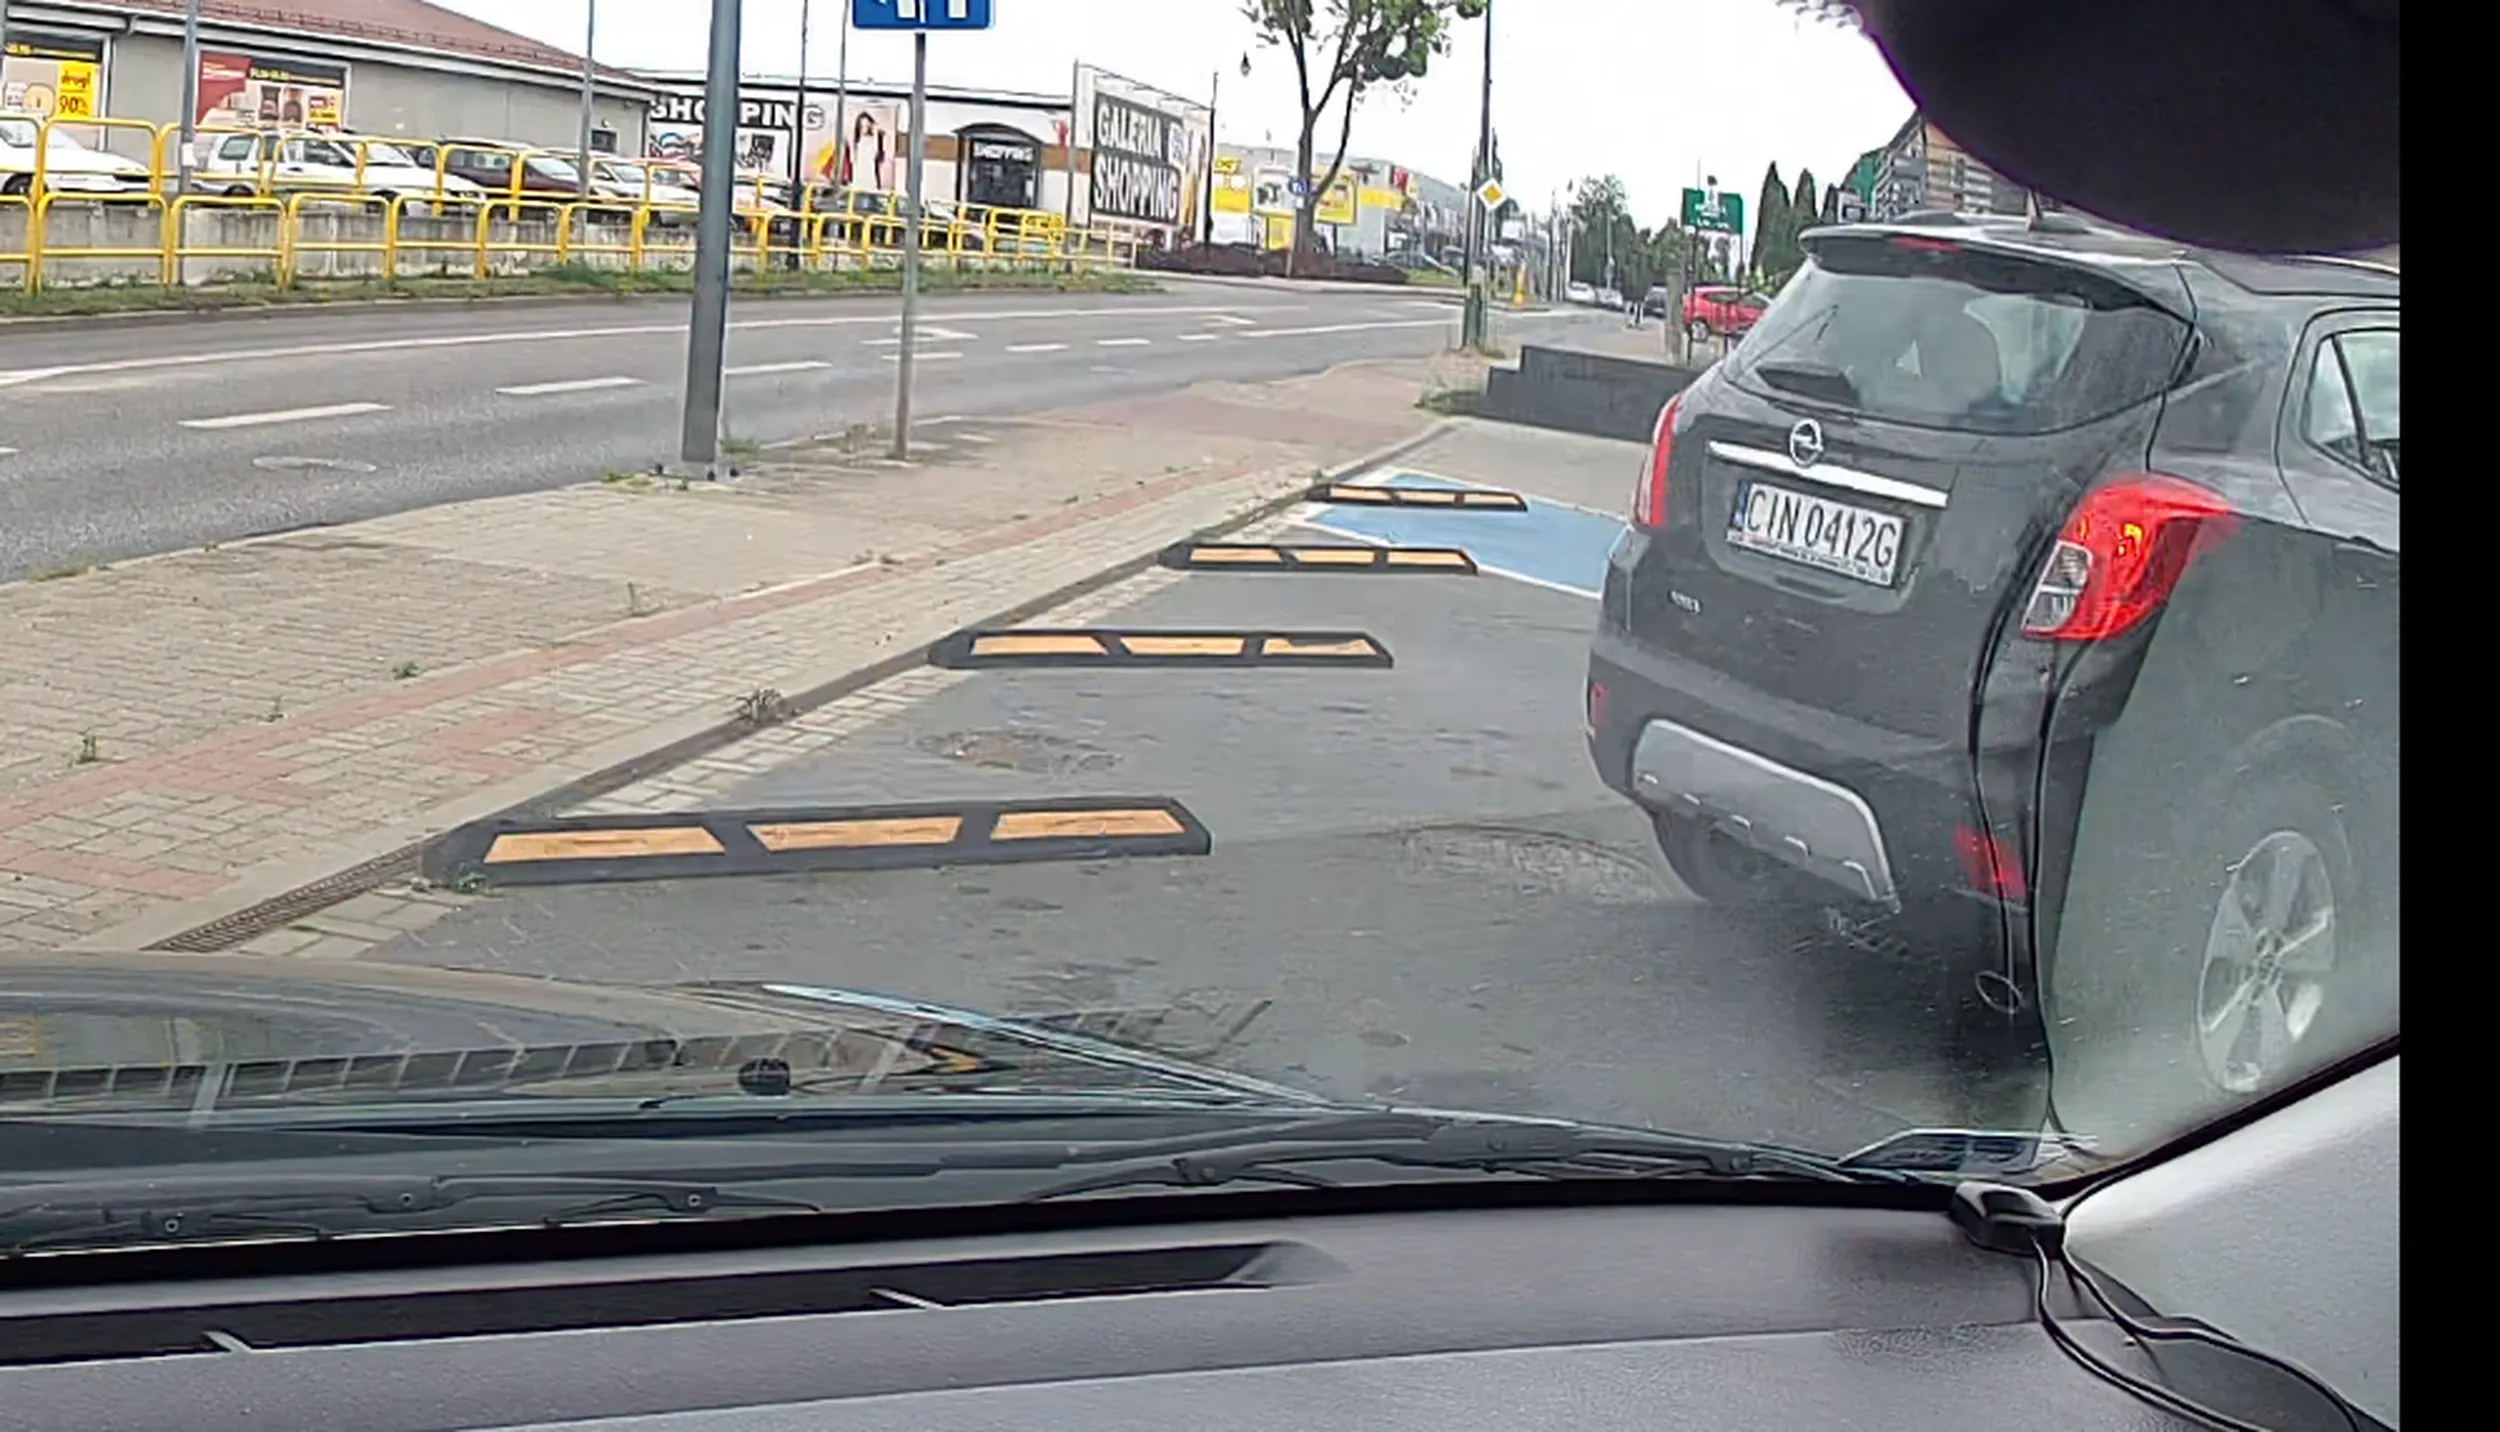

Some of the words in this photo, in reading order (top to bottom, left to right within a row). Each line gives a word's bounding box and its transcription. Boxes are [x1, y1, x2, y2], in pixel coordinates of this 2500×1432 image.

[651, 99, 824, 129] SHPING
[1098, 103, 1162, 157] GALERIA
[1094, 154, 1178, 220] SHOPPING
[1748, 489, 1801, 543] CIN
[1804, 504, 1897, 567] 0412G
